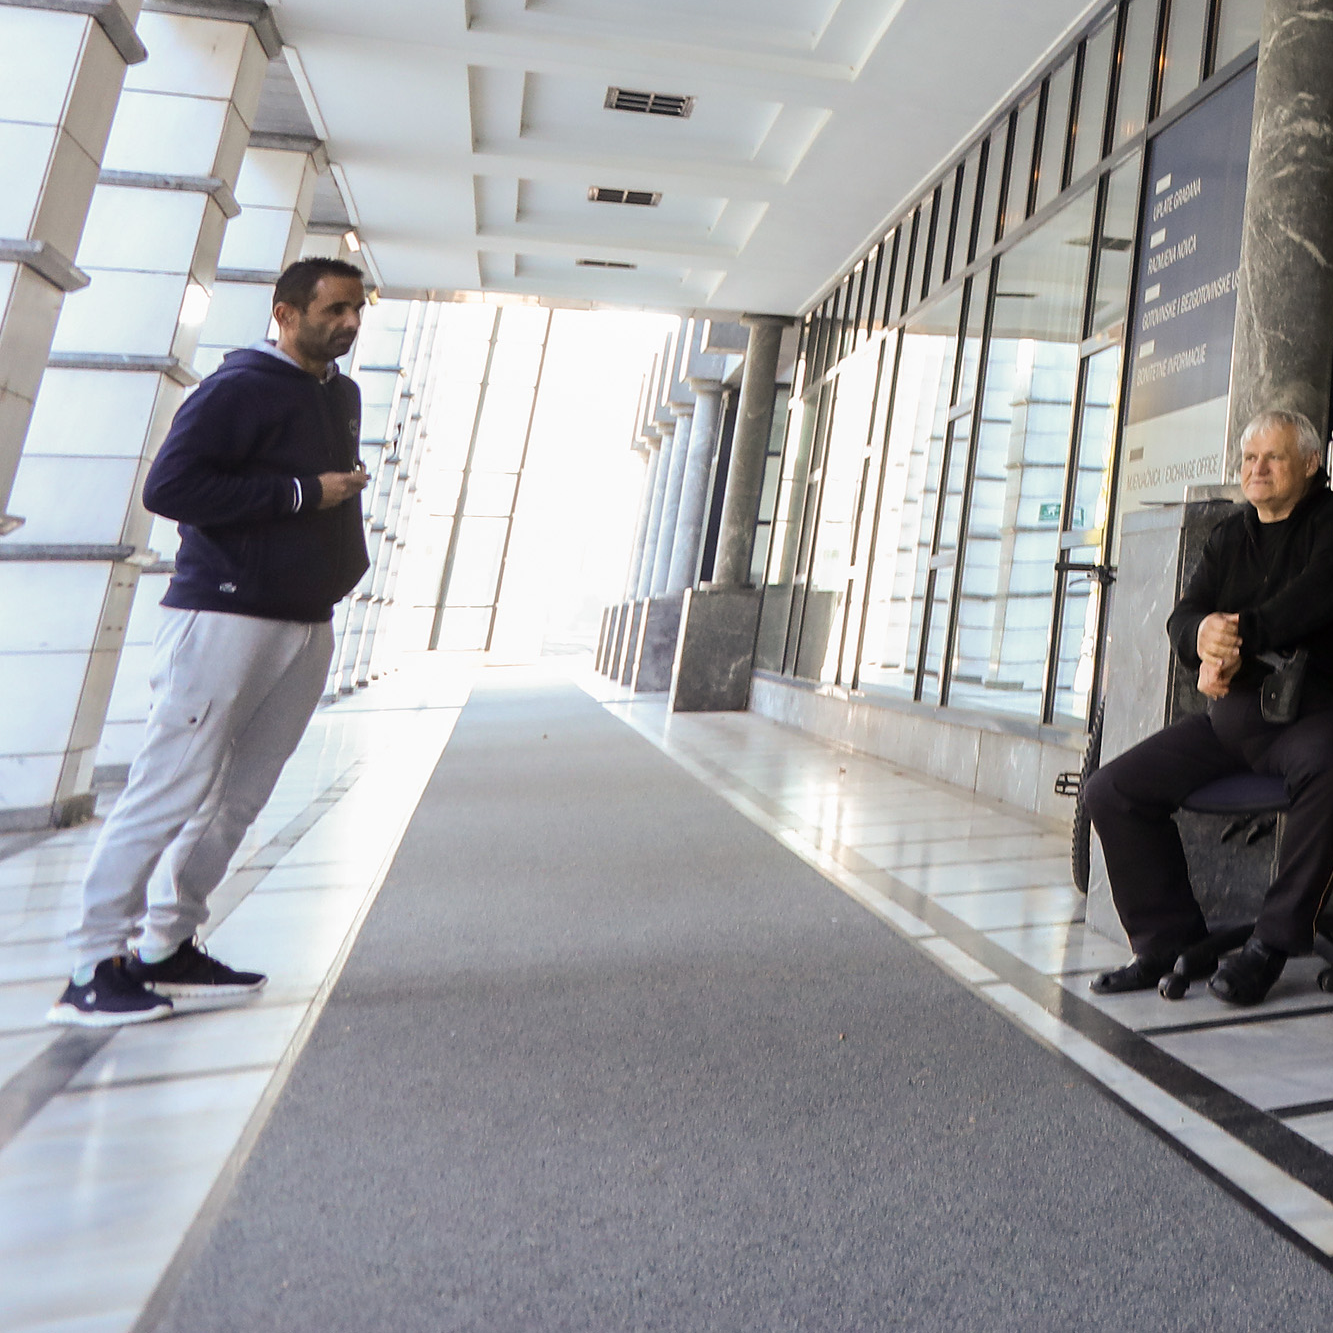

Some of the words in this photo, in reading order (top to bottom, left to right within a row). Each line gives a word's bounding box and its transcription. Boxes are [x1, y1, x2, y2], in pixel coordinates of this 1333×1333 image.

[1152, 193, 1174, 222] UPLATE
[1176, 233, 1197, 260] NOVCA
[1142, 300, 1177, 331] GOTOVINSKE
